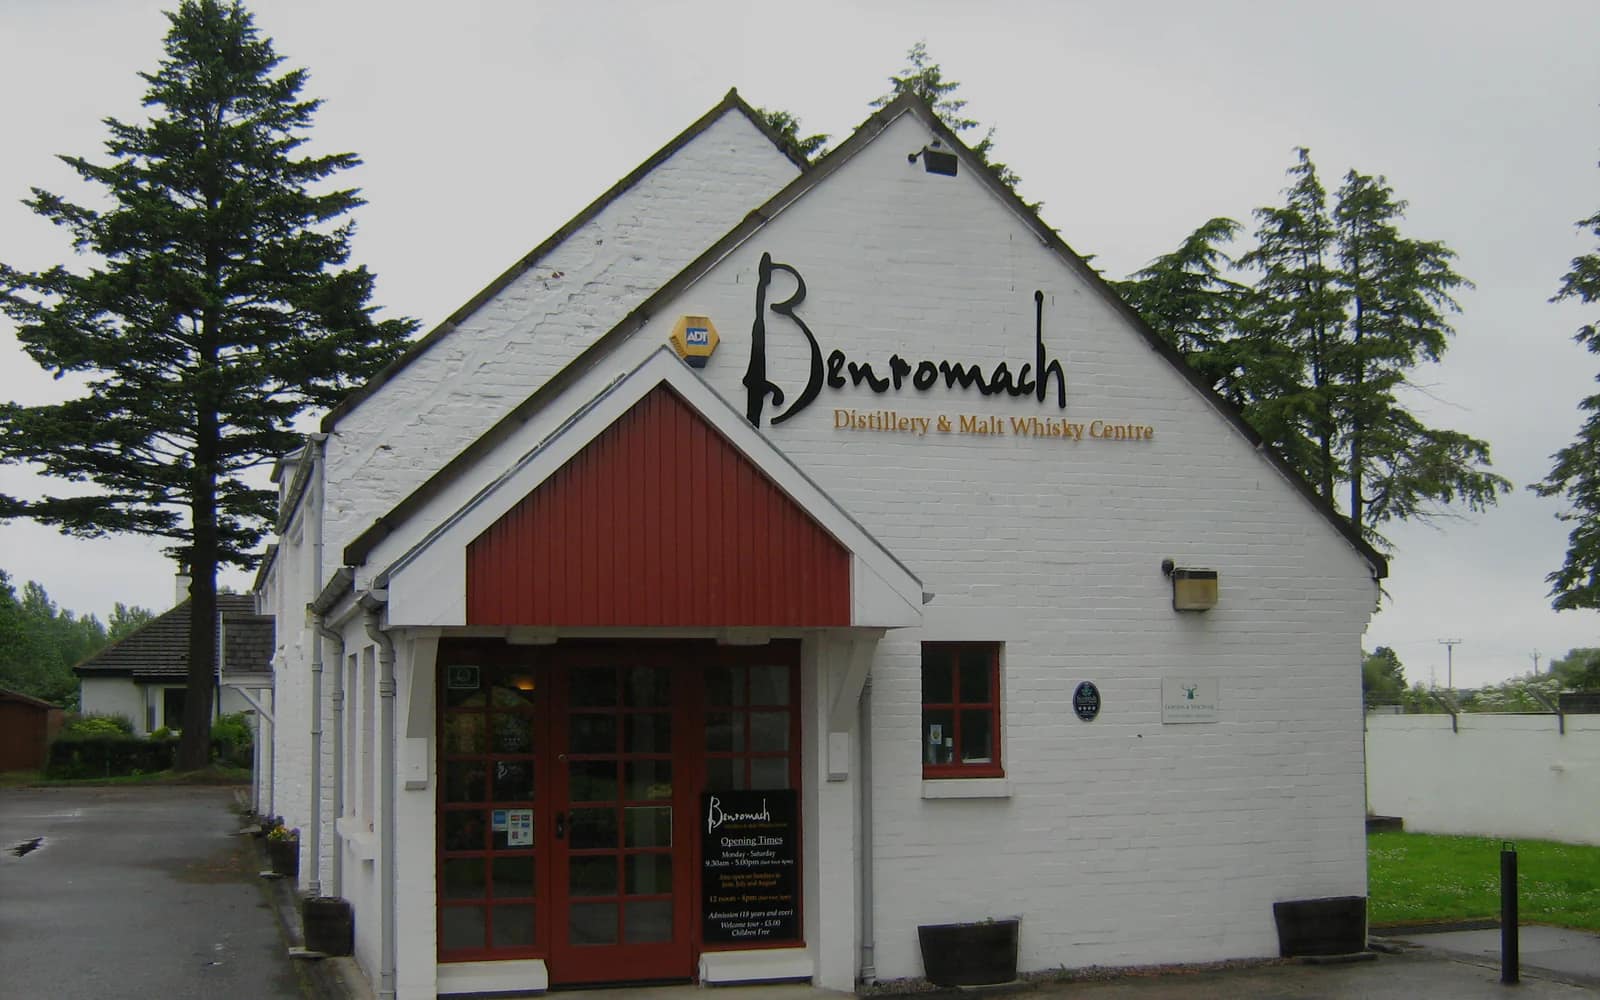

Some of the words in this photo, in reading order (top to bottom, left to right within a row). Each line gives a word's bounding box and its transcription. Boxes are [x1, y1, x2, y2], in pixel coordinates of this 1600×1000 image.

[687, 330, 708, 342] ADT
[743, 252, 1066, 428] Benromach
[833, 409, 931, 436] Distillery
[936, 414, 953, 432] &
[959, 414, 1004, 434] Malt
[1010, 416, 1084, 441] Whisky
[1089, 420, 1154, 439] Centre
[707, 795, 771, 835] Benromach
[720, 836, 757, 848] Opening
[758, 835, 784, 846] Times
[721, 850, 746, 859] Monday
[750, 849, 777, 858] Saturday
[708, 911, 739, 919] Admission
[766, 908, 778, 917] and
[720, 921, 746, 929] Welcome
[731, 928, 757, 937] Children
[757, 928, 770, 936] Free
